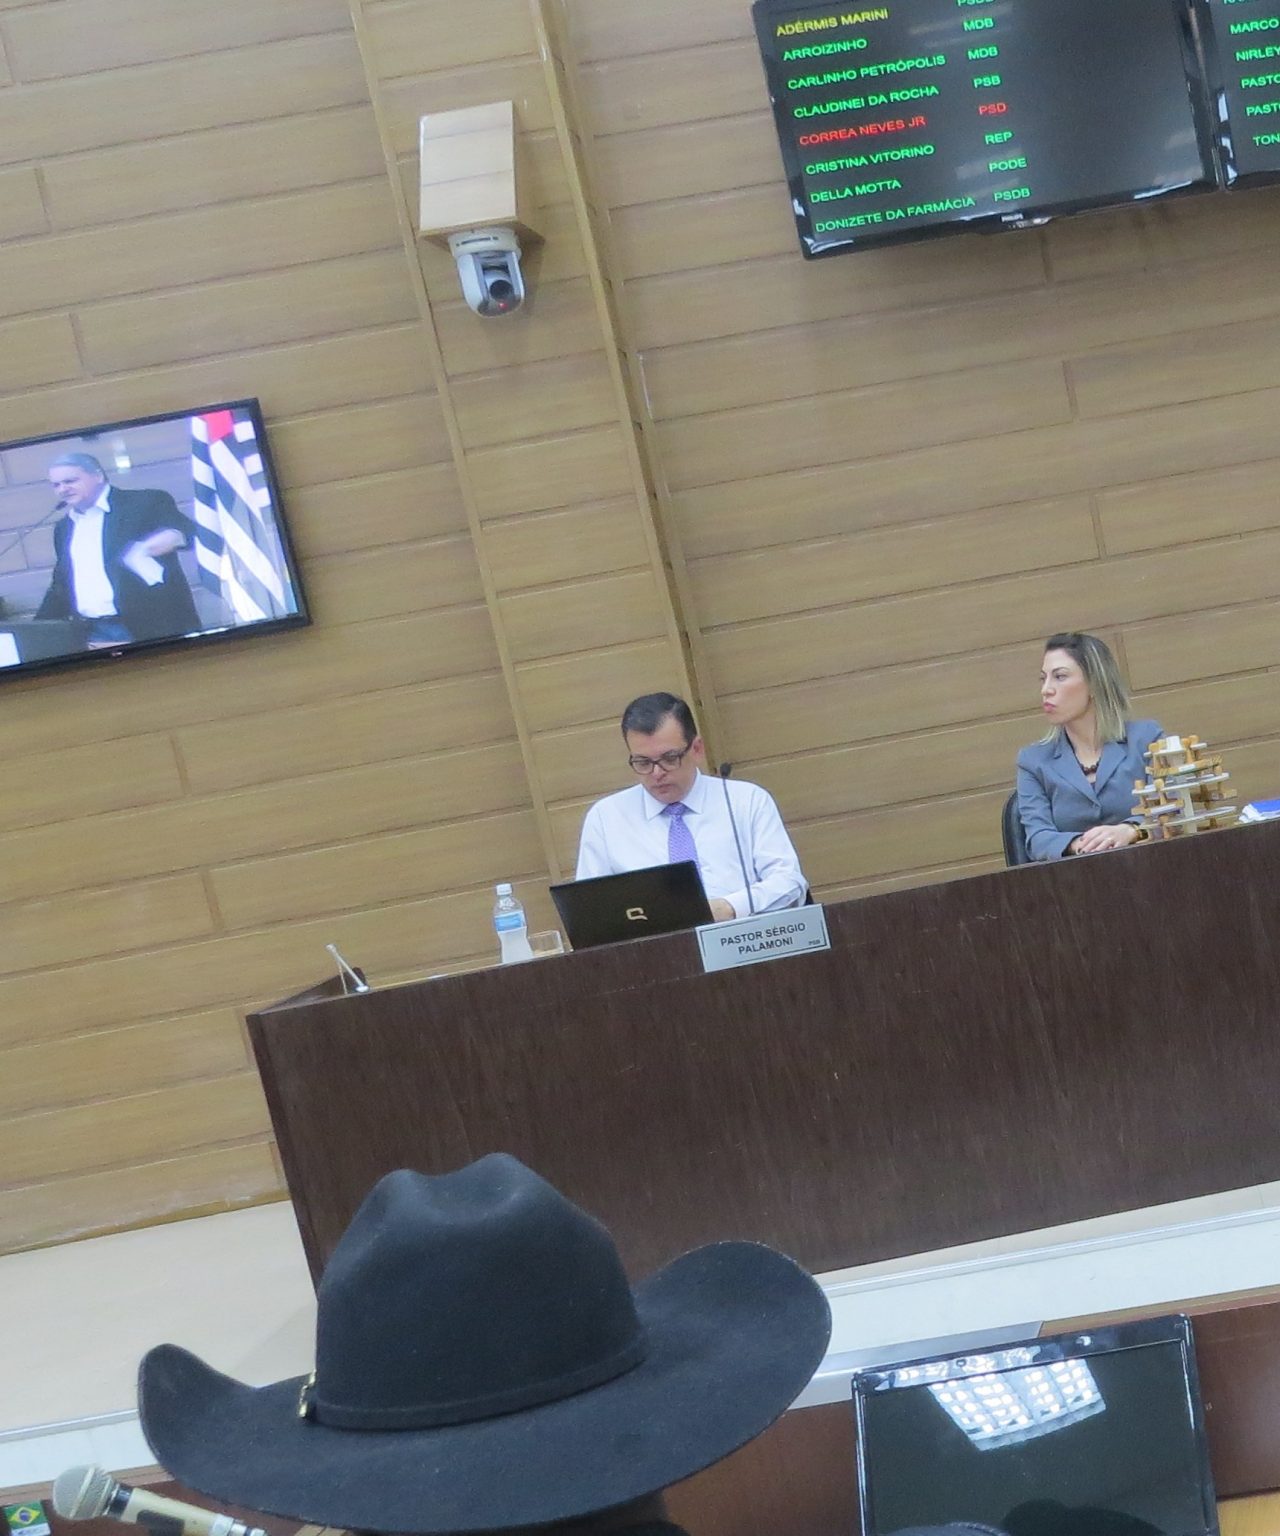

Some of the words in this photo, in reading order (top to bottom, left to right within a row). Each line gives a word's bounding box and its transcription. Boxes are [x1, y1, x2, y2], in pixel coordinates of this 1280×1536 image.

[776, 17, 838, 37] ADÉRMIS
[841, 8, 888, 26] MARINI
[963, 17, 993, 32] MDB
[1230, 18, 1280, 35] MARCO
[783, 38, 867, 61] ARROIZINHO
[967, 46, 998, 61] MDB
[787, 70, 857, 90] CARLINHO
[860, 55, 946, 79] PETRÓPOLIS
[973, 75, 1001, 88] PSB
[794, 97, 865, 118] CLAUDINEI
[868, 94, 888, 107] DA
[890, 85, 939, 103] ROCHA
[979, 103, 1007, 116] PSD
[799, 128, 857, 146] CORREA
[859, 119, 905, 135] NEVES
[909, 115, 926, 128] JR
[985, 131, 1012, 145] REP
[805, 156, 868, 176] CRISTINA
[870, 145, 934, 164] VITORINO
[989, 157, 1027, 173] PODE
[810, 188, 853, 204] DELLA
[855, 179, 902, 195] MOTTA
[994, 187, 1030, 202] PSDB
[816, 212, 883, 233] DONIZETE
[886, 208, 904, 221] DA
[907, 196, 976, 217] FARMÁCIA
[720, 930, 763, 947] PASTOR
[765, 922, 806, 938] SÉRGIO
[738, 937, 793, 955] PALAMONI
